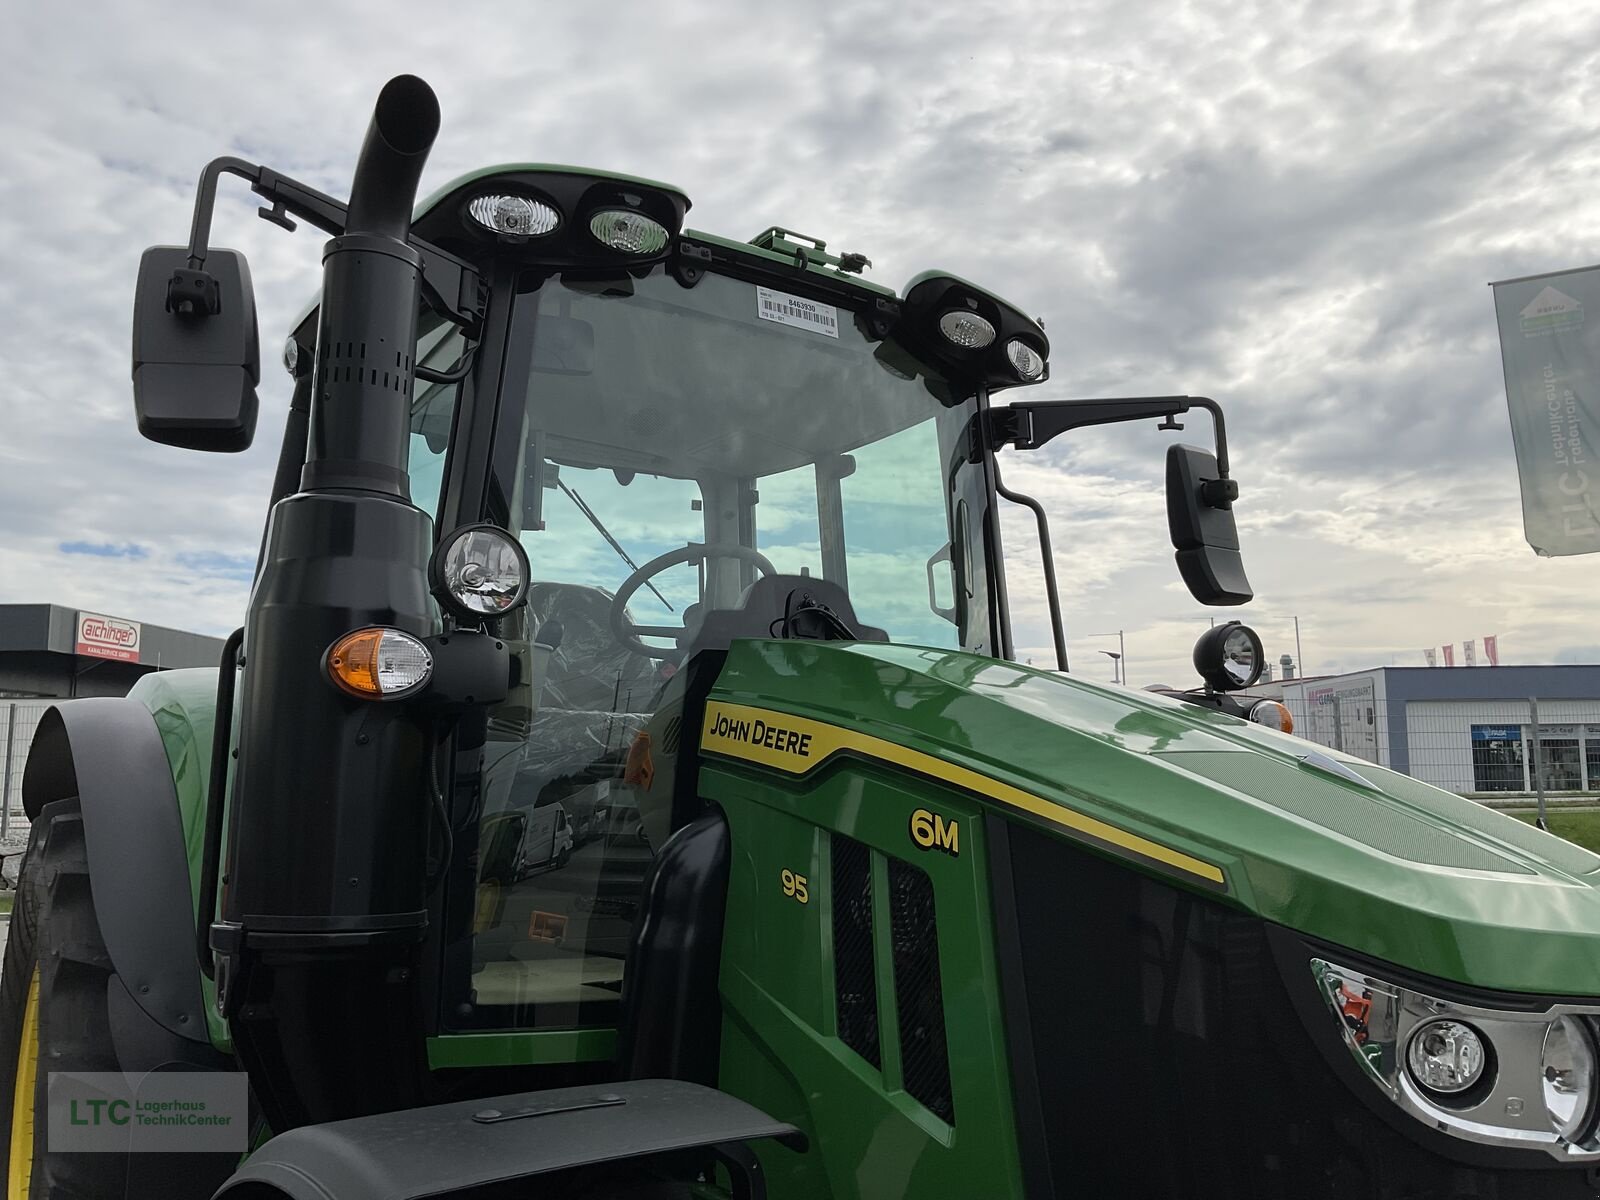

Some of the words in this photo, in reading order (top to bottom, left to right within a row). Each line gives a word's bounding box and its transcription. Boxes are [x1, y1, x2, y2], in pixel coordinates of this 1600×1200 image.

[788, 299, 816, 313] 8463930
[85, 622, 134, 644] aichinger
[710, 711, 751, 743] JOHN
[751, 719, 813, 757] DEERE
[909, 808, 960, 857] 6M
[781, 867, 809, 904] 95
